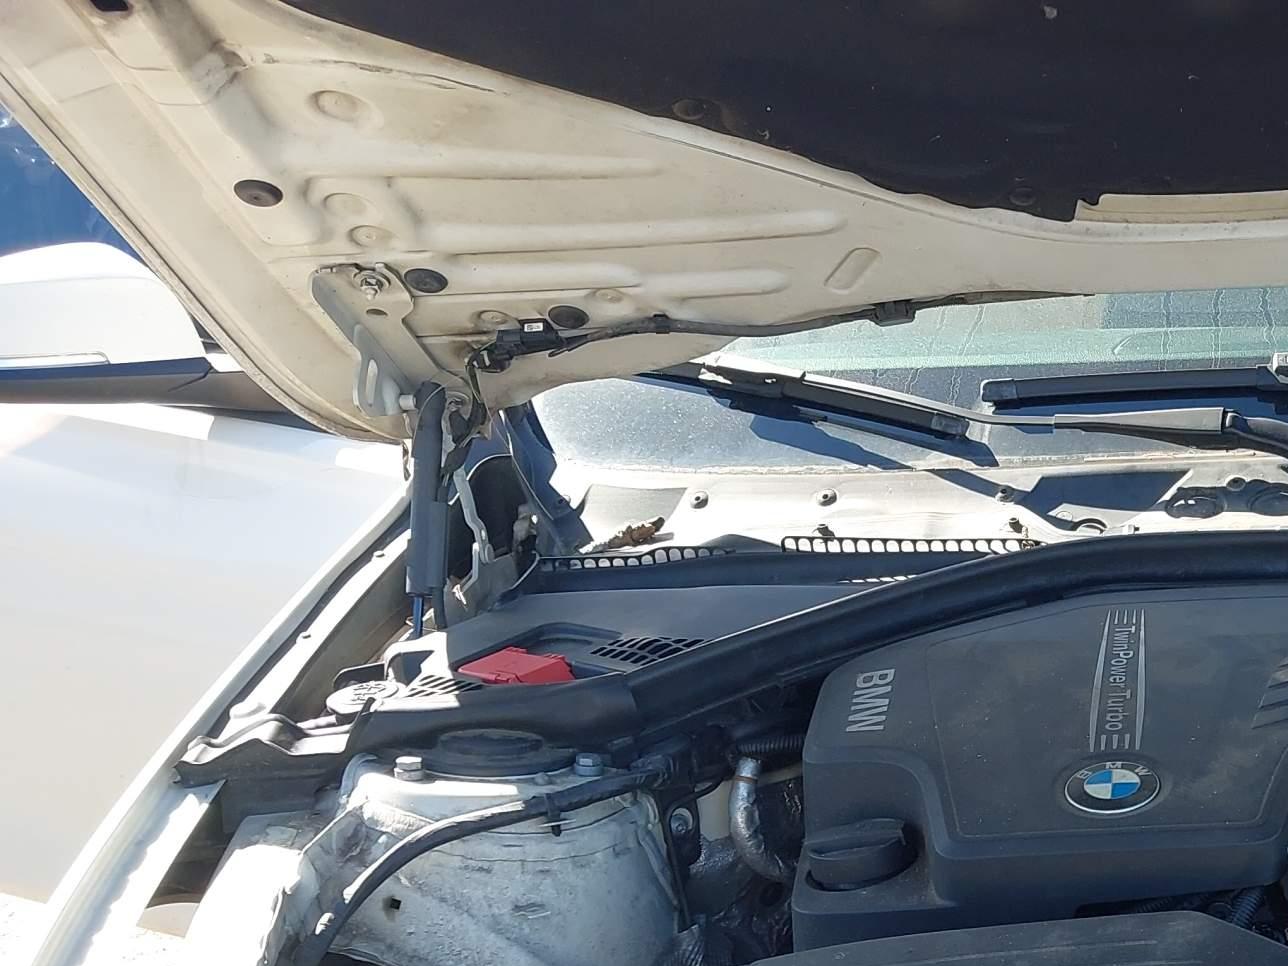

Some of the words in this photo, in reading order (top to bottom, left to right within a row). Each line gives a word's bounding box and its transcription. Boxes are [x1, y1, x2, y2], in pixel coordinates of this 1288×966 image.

[1108, 625, 1136, 688] TwinPower
[845, 668, 896, 732] BMW
[1104, 689, 1131, 731] Turbo
[1076, 761, 1153, 780] BMW
